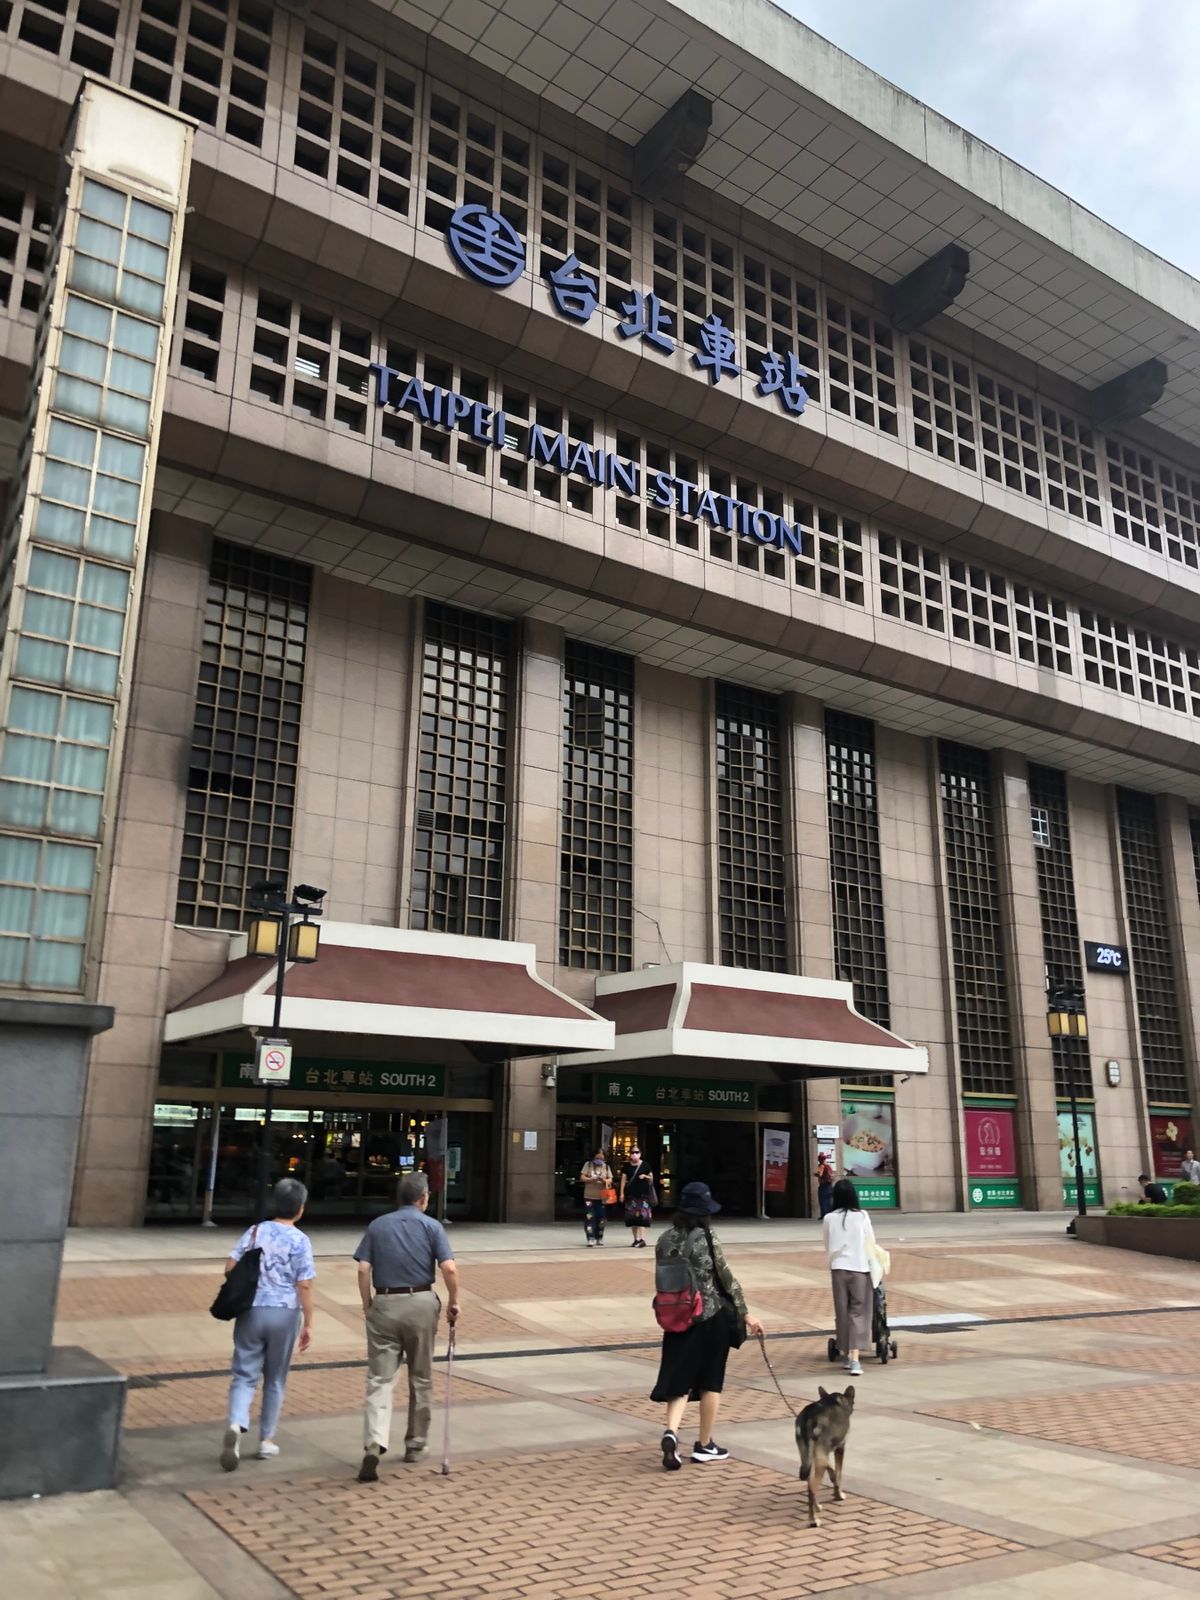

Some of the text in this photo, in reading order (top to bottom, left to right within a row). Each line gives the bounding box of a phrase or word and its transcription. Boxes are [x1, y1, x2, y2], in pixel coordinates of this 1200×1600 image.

[549, 253, 812, 416] 台北車站
[369, 363, 804, 556] TAIPEI MAIN STATION
[305, 1067, 374, 1086] 台北車站
[380, 1072, 425, 1086] SOUTH
[427, 1075, 437, 1087] 2
[608, 1082, 621, 1097] 南
[626, 1086, 634, 1097] 2
[708, 1090, 742, 1102] SOUTH
[742, 1092, 750, 1103] 2
